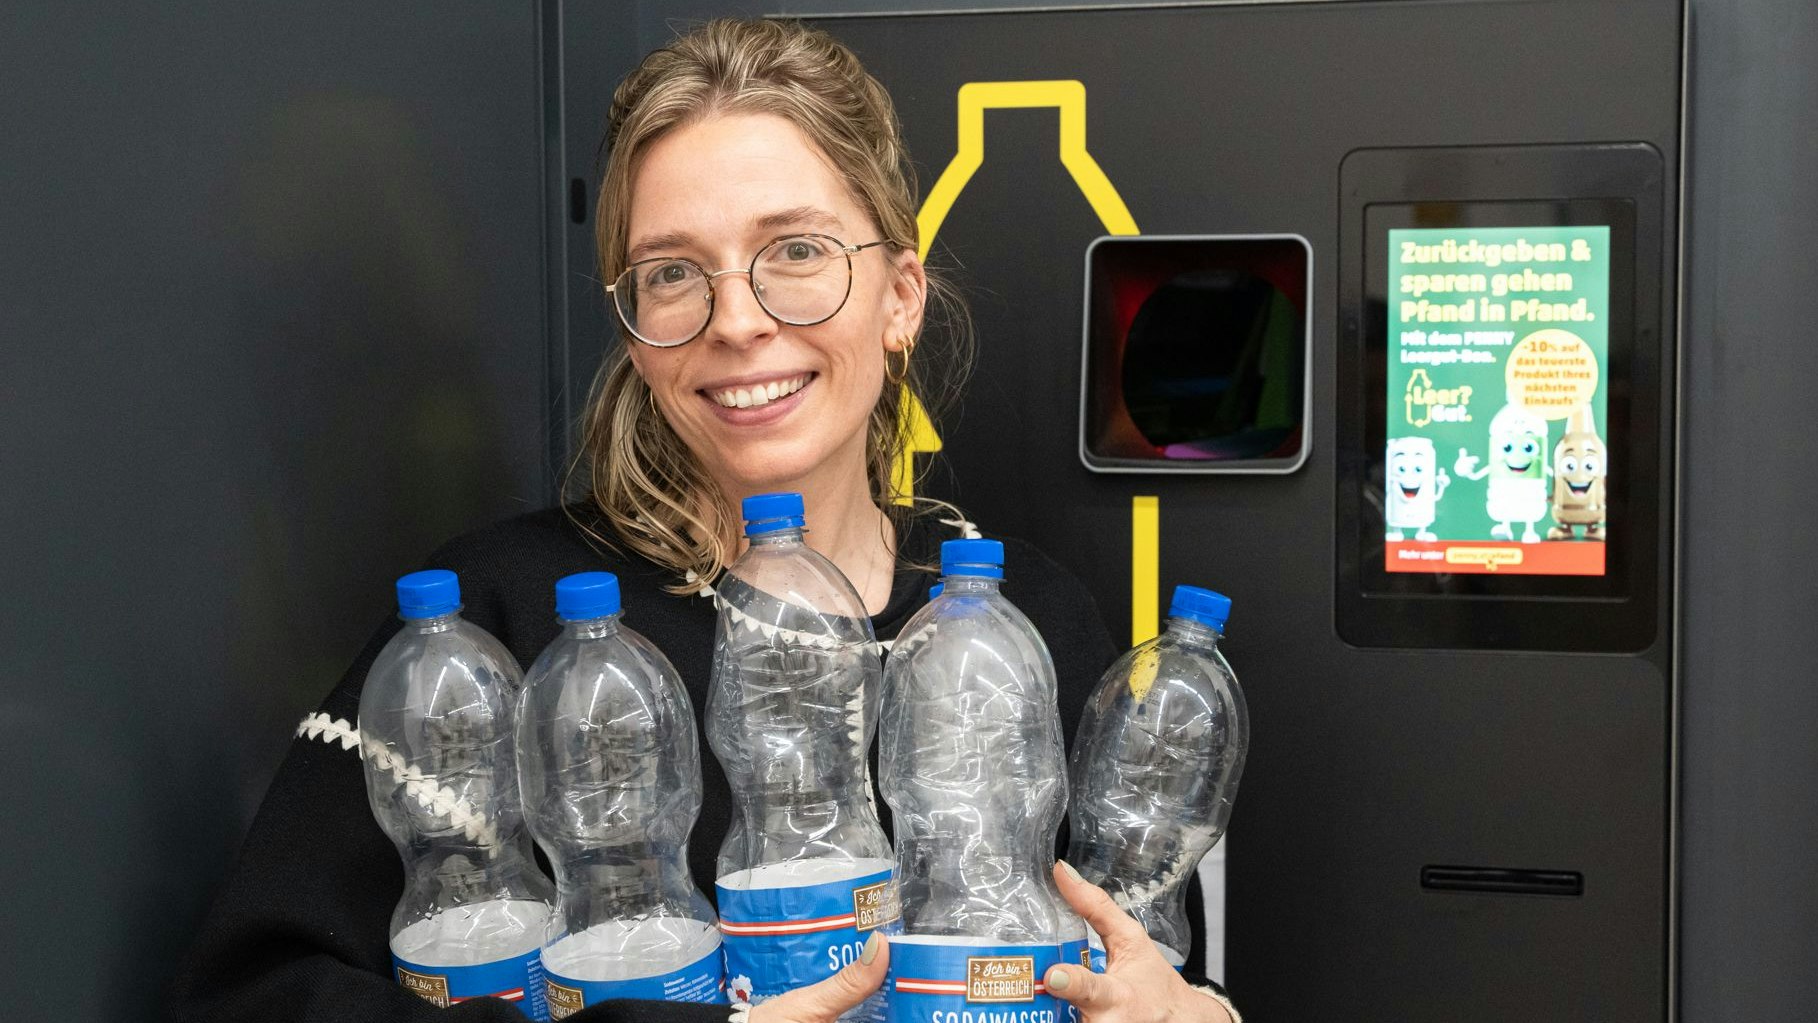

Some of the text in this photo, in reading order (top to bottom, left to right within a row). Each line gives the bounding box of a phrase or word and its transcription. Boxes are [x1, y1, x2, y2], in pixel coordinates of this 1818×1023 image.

[1400, 238, 1591, 267] Zurückgeben &
[1400, 268, 1573, 297] sparen gehen
[1400, 297, 1595, 322] Pfand in Pfand.
[1400, 330, 1427, 346] Mit
[1428, 331, 1463, 346] dem
[1561, 343, 1580, 353] auf
[1516, 356, 1587, 366] das teuerste
[1513, 369, 1560, 379] Produkt
[1413, 385, 1473, 405] Leer?
[1524, 383, 1577, 393] nächsten
[1431, 405, 1473, 422] Gut.
[983, 961, 1021, 977] Ich bin
[418, 979, 433, 991] bin
[973, 978, 1030, 997] ÖSTERREICH
